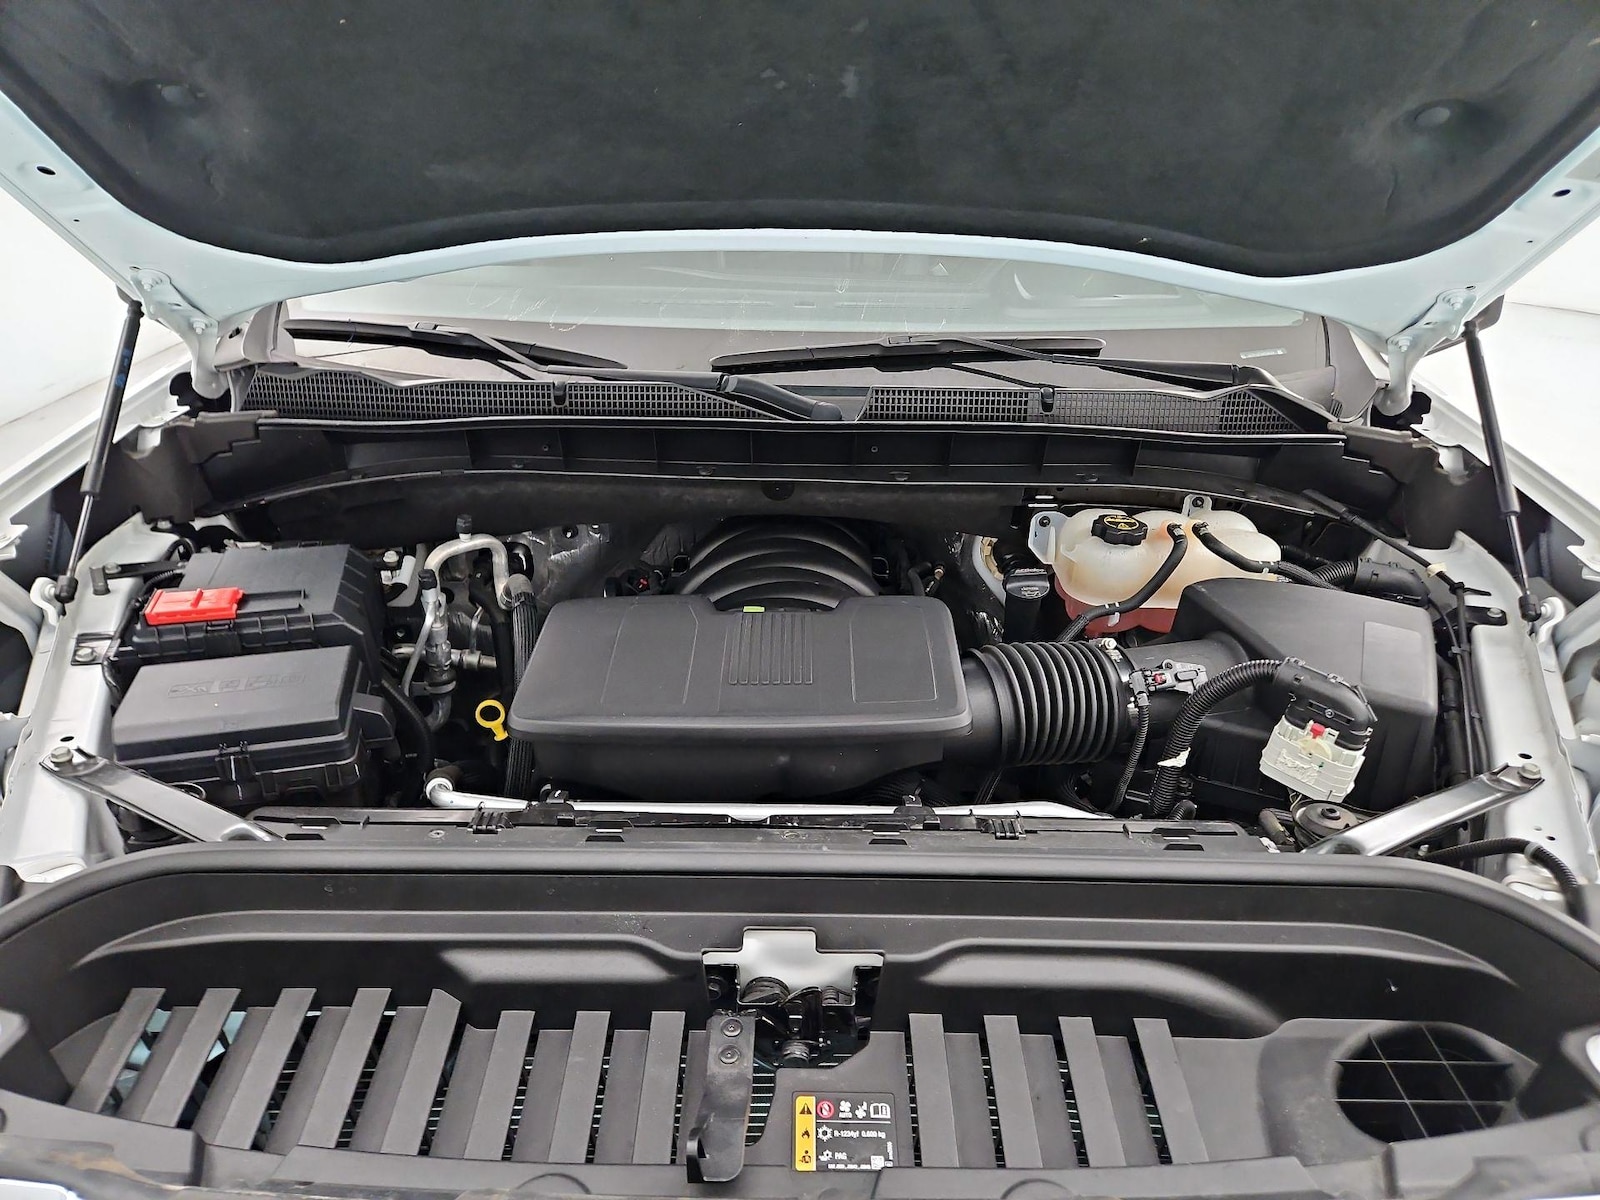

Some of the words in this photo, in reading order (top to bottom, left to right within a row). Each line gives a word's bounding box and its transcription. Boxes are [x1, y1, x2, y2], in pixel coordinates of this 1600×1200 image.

[833, 1130, 860, 1139] R-1234yf
[878, 1130, 886, 1139] kg
[834, 1152, 848, 1160] PAG
